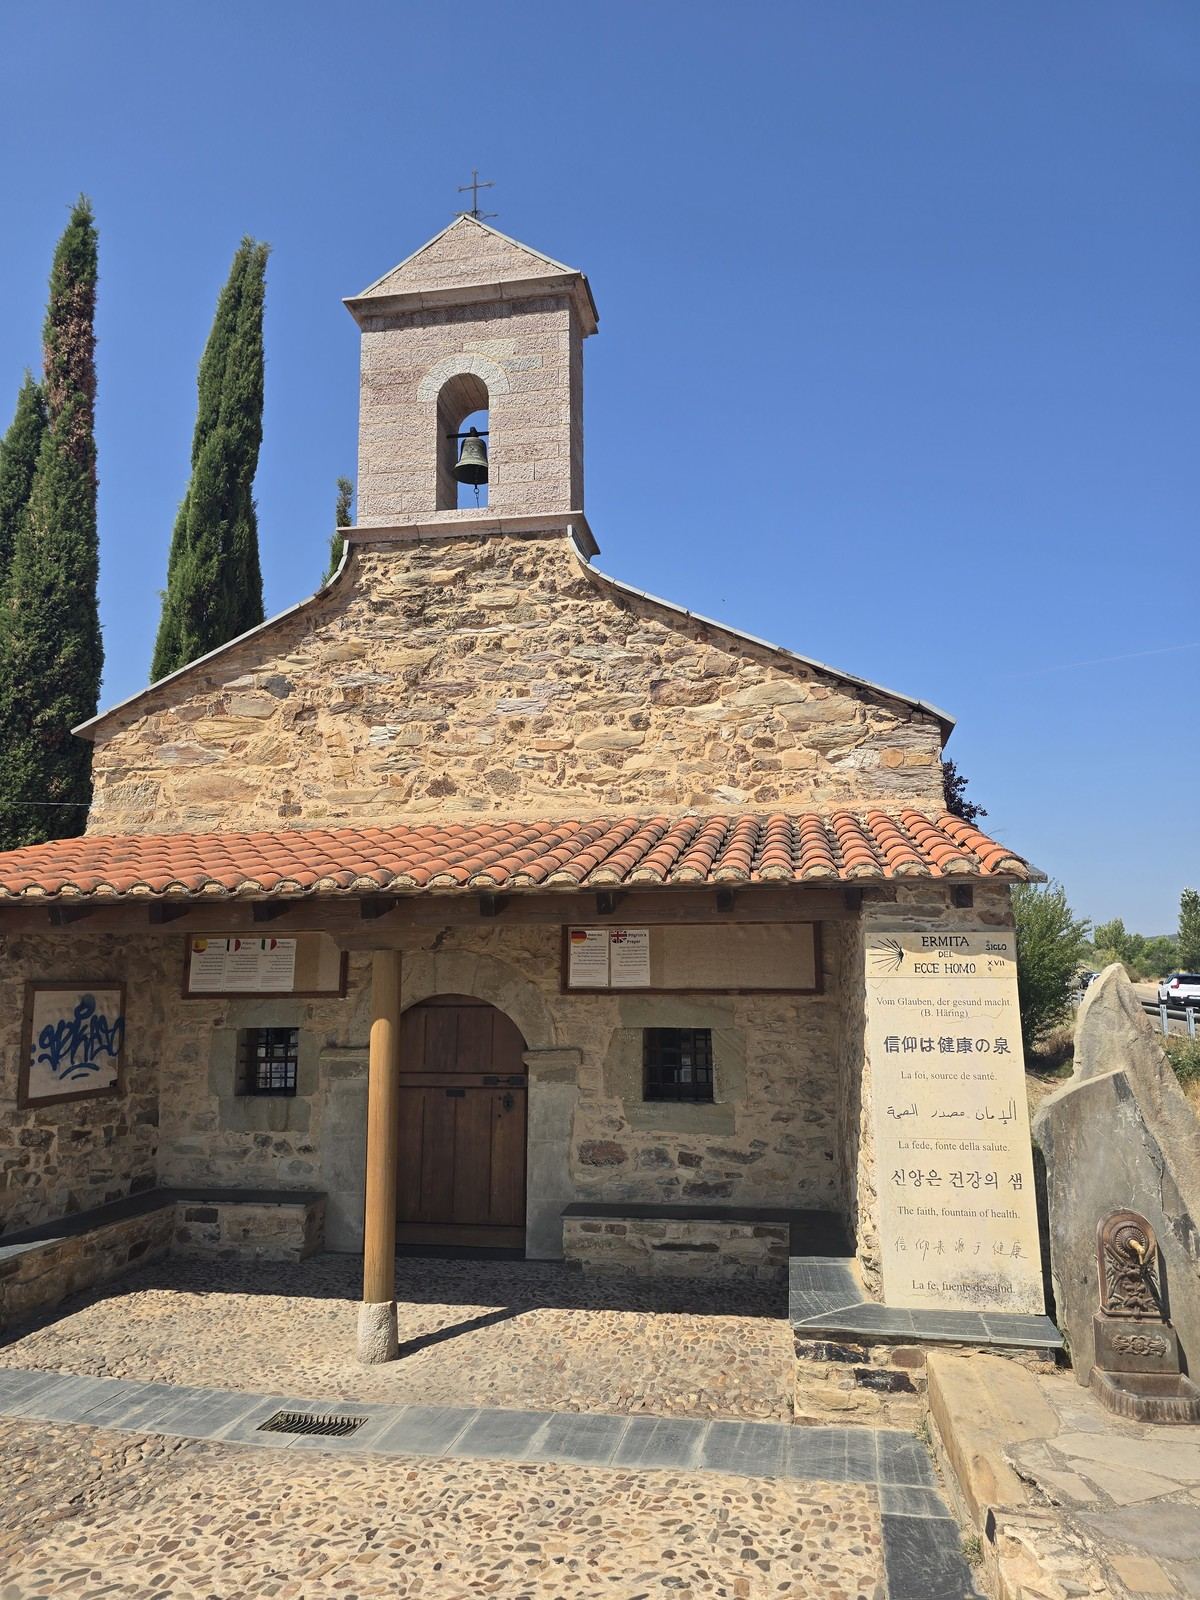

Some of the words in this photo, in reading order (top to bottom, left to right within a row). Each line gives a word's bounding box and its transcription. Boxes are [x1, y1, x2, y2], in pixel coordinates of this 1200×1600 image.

[922, 936, 970, 946] ERMITA
[914, 963, 940, 974] ECCE
[944, 963, 976, 974] HOMO
[876, 998, 896, 1006] Vom
[898, 997, 935, 1007] Glauben,
[936, 998, 950, 1006] der
[952, 998, 982, 1008] gesund
[920, 1008, 933, 1018] (B.
[936, 1008, 969, 1018] Häring)
[884, 1035, 1011, 1054] 信仰は健康の泉
[901, 1071, 912, 1079] La
[914, 1071, 928, 1080] foi,
[960, 1072, 970, 1080] de
[973, 1072, 998, 1081] santé.
[931, 1109, 965, 1118] مصدر
[898, 1141, 909, 1149] La
[912, 1141, 933, 1150] fede,
[935, 1142, 956, 1150] fonte
[959, 1142, 980, 1151] della
[982, 1143, 1010, 1152] salute.
[891, 1169, 942, 1187] 신앙은
[949, 1171, 998, 1189] 건강의
[1008, 1172, 1023, 1190] 샘
[897, 1206, 914, 1215] The
[916, 1207, 938, 1216] faith,
[941, 1207, 977, 1217] fountain
[979, 1208, 990, 1218] of
[991, 1208, 1020, 1219] health.
[912, 1280, 925, 1290] La
[927, 1280, 938, 1291] fe,
[942, 1281, 970, 1292] fuente
[972, 1282, 984, 1292] de
[987, 1283, 1015, 1294] salud.
